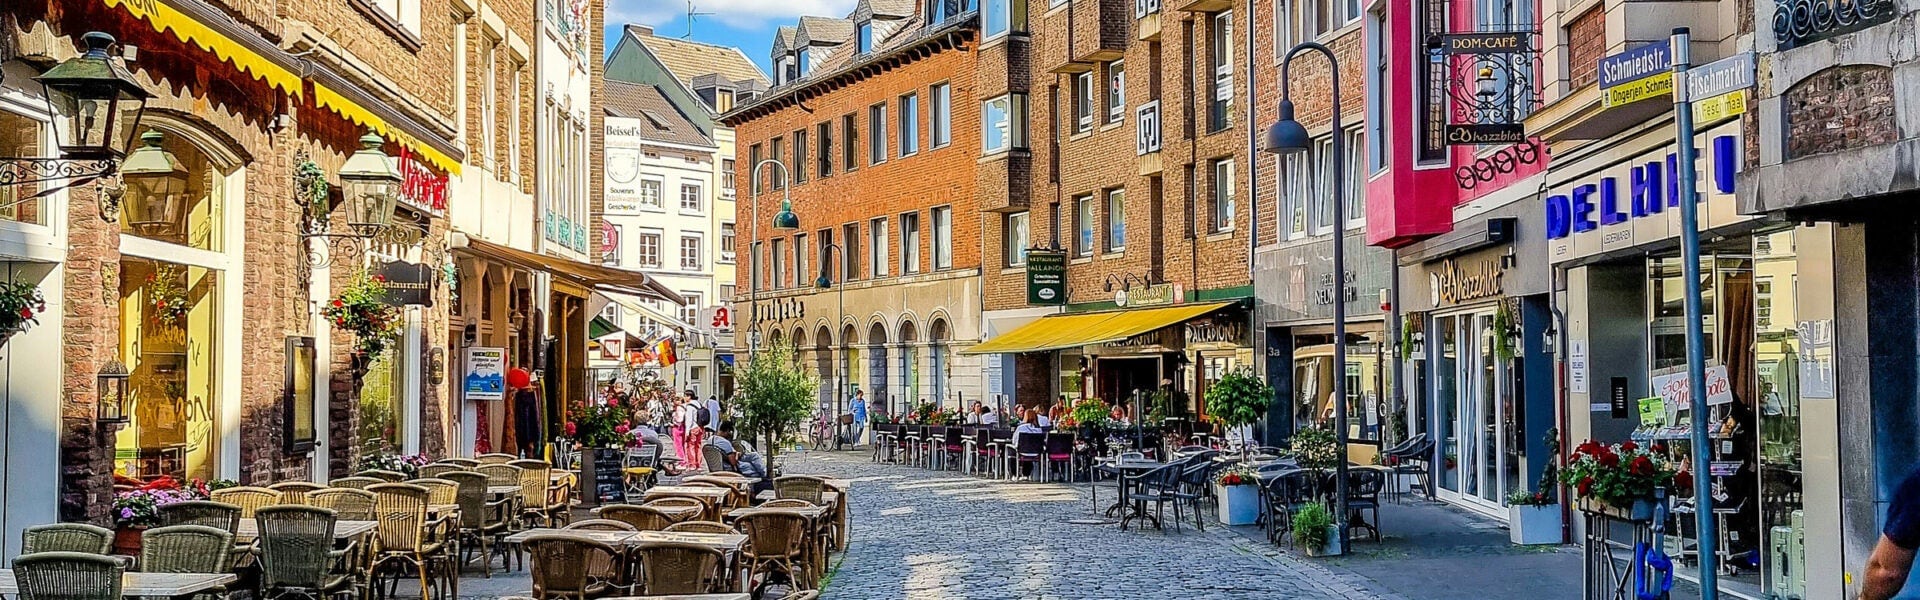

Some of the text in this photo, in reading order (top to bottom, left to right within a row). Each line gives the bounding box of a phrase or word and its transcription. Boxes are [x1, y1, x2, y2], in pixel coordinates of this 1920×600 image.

[1452, 36, 1518, 49] DOM-CAFÉ
[1604, 47, 1668, 84] Schmiedstr.
[1688, 58, 1746, 97] Fischmarkt
[1612, 85, 1643, 103] Ongerjen
[606, 125, 640, 137] Beissel's
[1129, 285, 1169, 299] RESTAURANT
[1268, 347, 1280, 357] 3a
